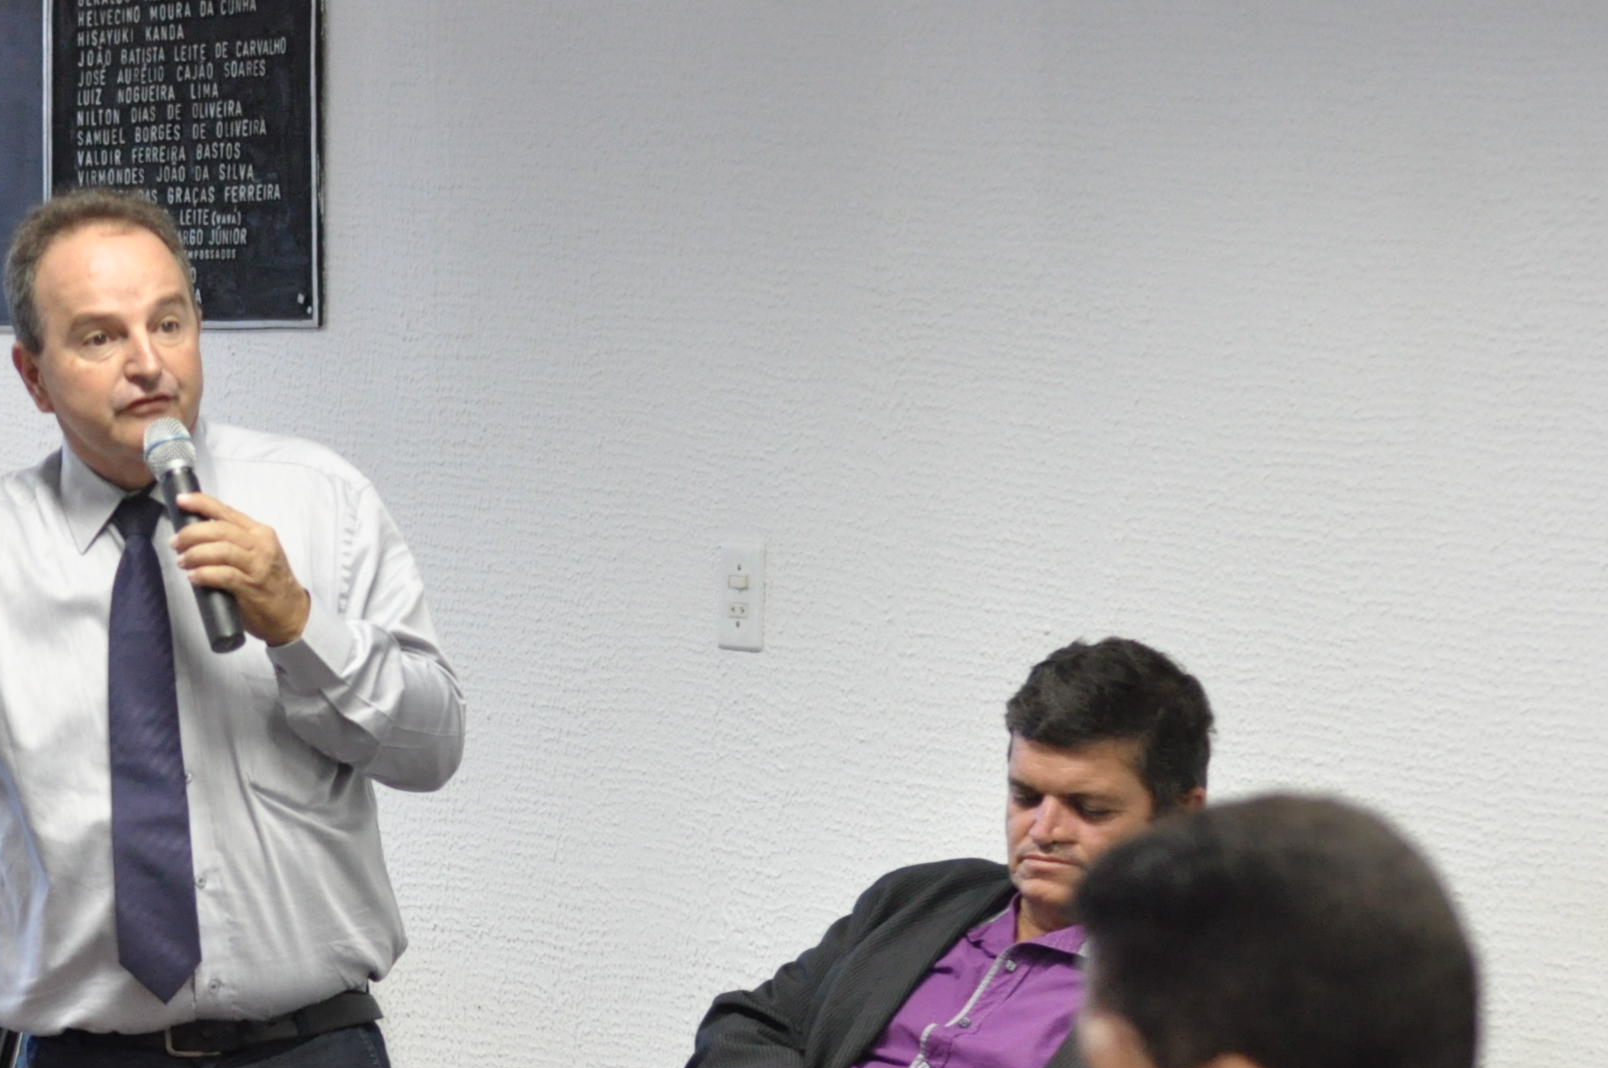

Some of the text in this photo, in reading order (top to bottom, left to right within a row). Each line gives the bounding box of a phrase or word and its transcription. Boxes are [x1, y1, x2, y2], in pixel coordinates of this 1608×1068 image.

[148, 2, 191, 21] MOURA
[199, 1, 214, 18] DA
[219, 0, 256, 16] CUNHA
[78, 25, 183, 46] HISAYUKI KANDA
[78, 38, 287, 67] JOÃO BATISTA LEITE DE CARVALHO
[78, 65, 106, 86] JOSÉ
[223, 61, 265, 79] SOARES
[77, 84, 218, 105] LUIZ NOGUEIRA LIMA
[77, 101, 242, 126] NILTON DIAS DE OLIVEIRA
[77, 121, 265, 146] SAMUEL BORGES DE OLIVEIRA
[77, 143, 239, 166] VALDIR FERREIRA BASTOS
[156, 163, 185, 183] JOÃO
[194, 166, 208, 182] DA
[218, 165, 254, 181] SILVA
[166, 185, 280, 206] GRAÇAS FERREIRA
[180, 209, 209, 226] LEITE
[208, 225, 247, 245] JÚNIOR
